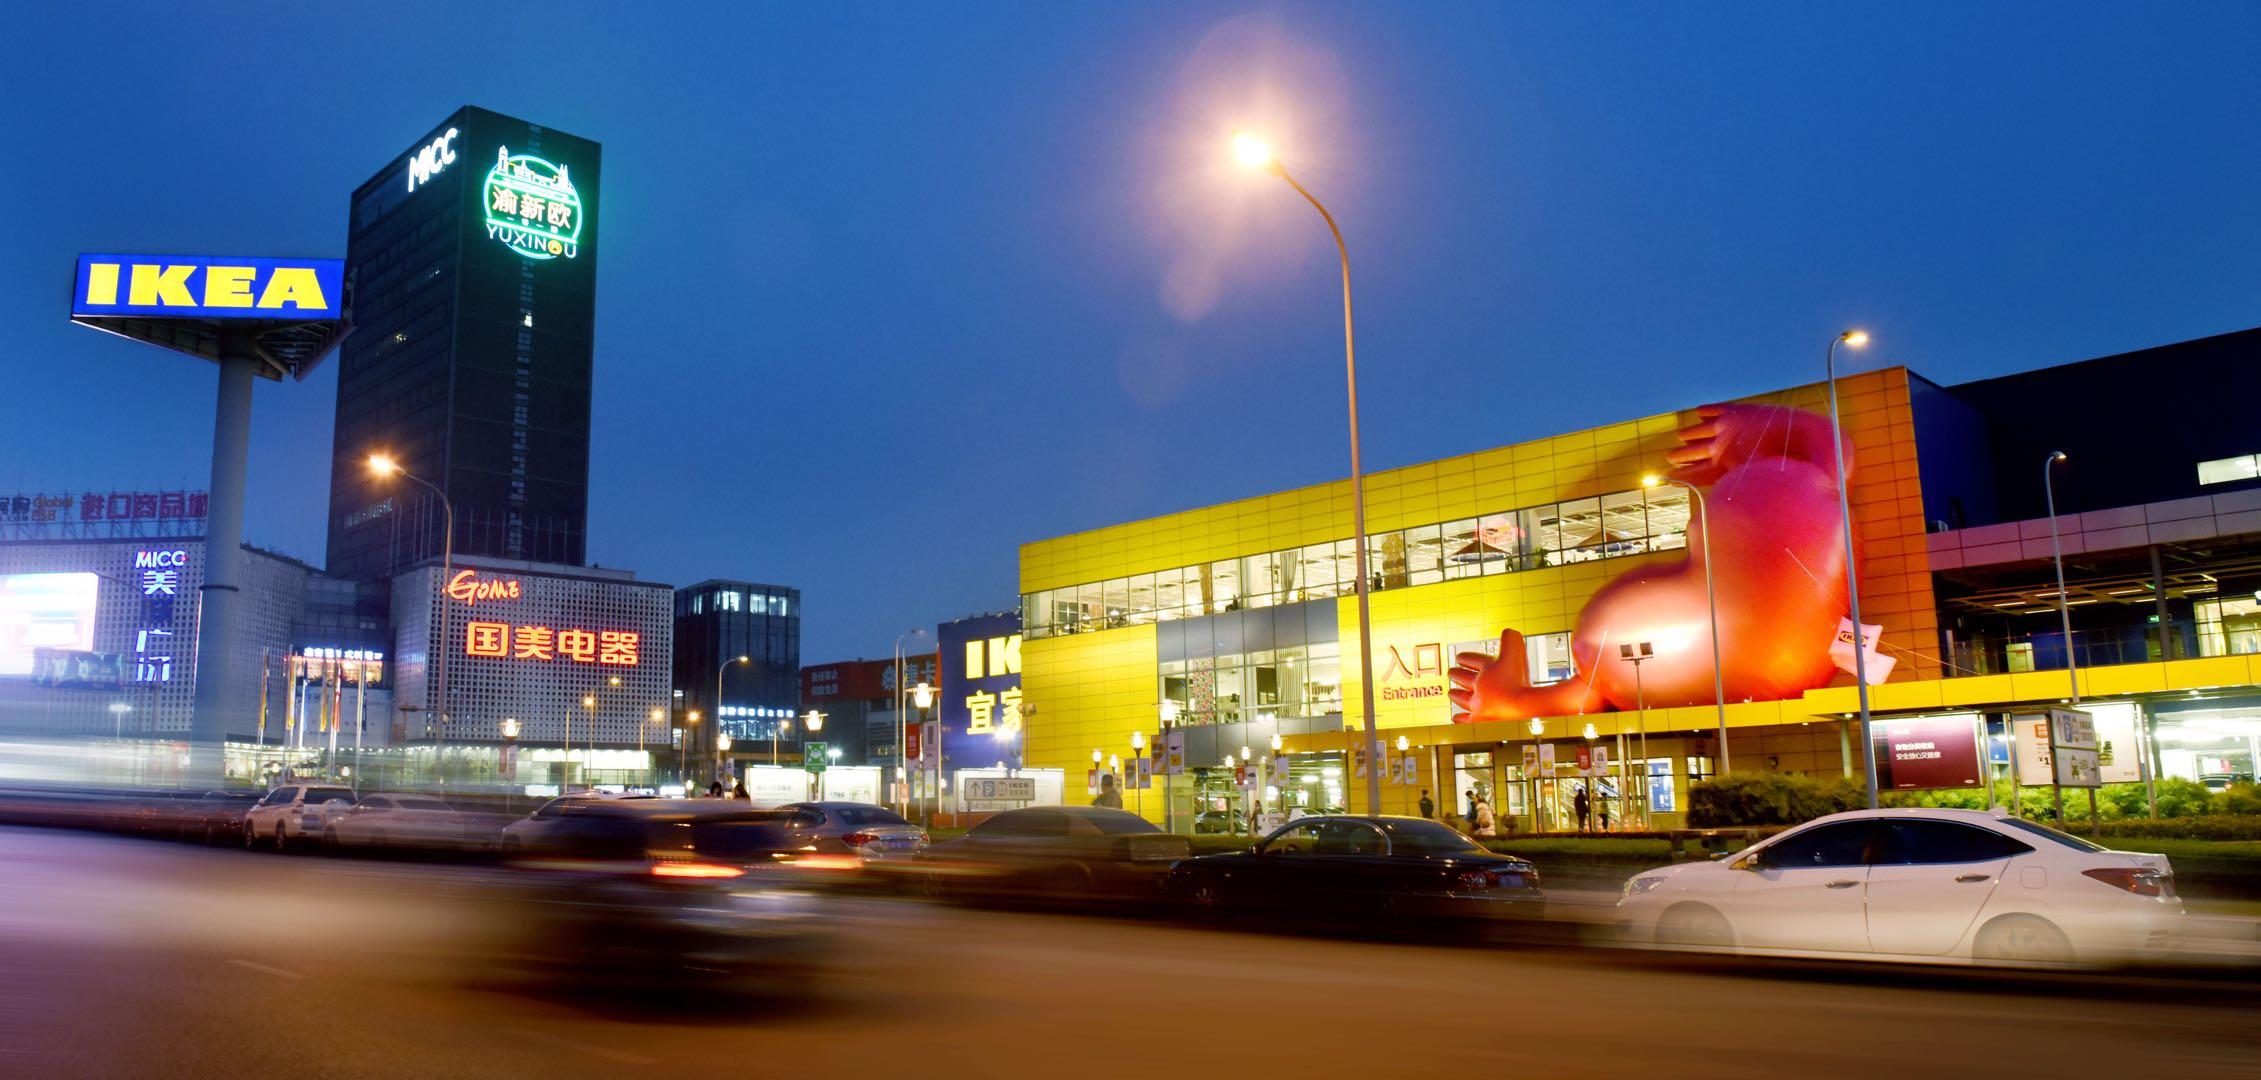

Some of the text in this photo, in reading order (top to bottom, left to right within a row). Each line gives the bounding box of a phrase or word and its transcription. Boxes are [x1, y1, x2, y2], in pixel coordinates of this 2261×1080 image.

[408, 128, 458, 193] MICC
[492, 185, 572, 230] 渝新欧
[486, 223, 577, 259] YUXINOU
[86, 263, 328, 310] IKEA
[135, 551, 187, 569] MICC
[466, 621, 639, 665] 国美电器
[1381, 642, 1442, 682] 入口
[1383, 685, 1443, 701] Entrance
